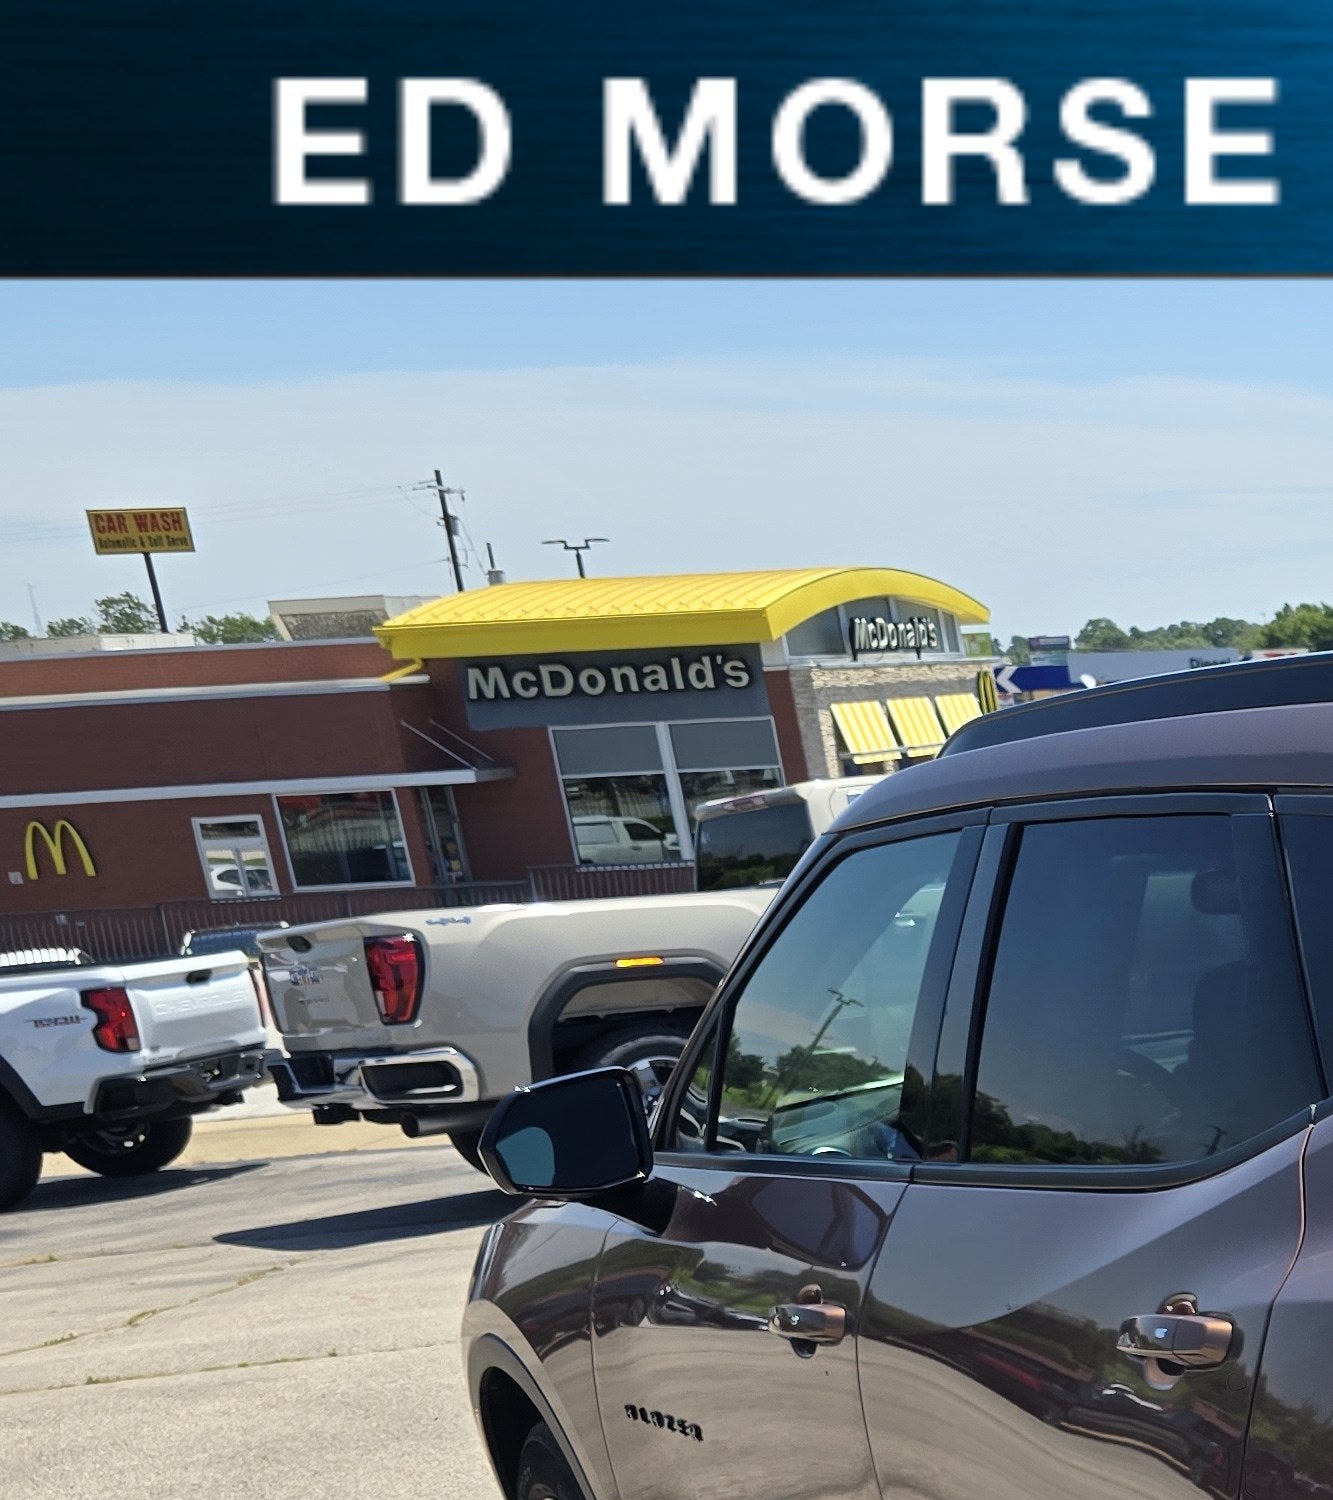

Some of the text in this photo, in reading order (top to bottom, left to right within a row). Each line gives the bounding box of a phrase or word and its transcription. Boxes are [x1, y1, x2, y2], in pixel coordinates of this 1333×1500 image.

[93, 511, 183, 534] CAR WASH
[853, 616, 938, 651] McDonald's
[466, 654, 751, 700] McDonald's
